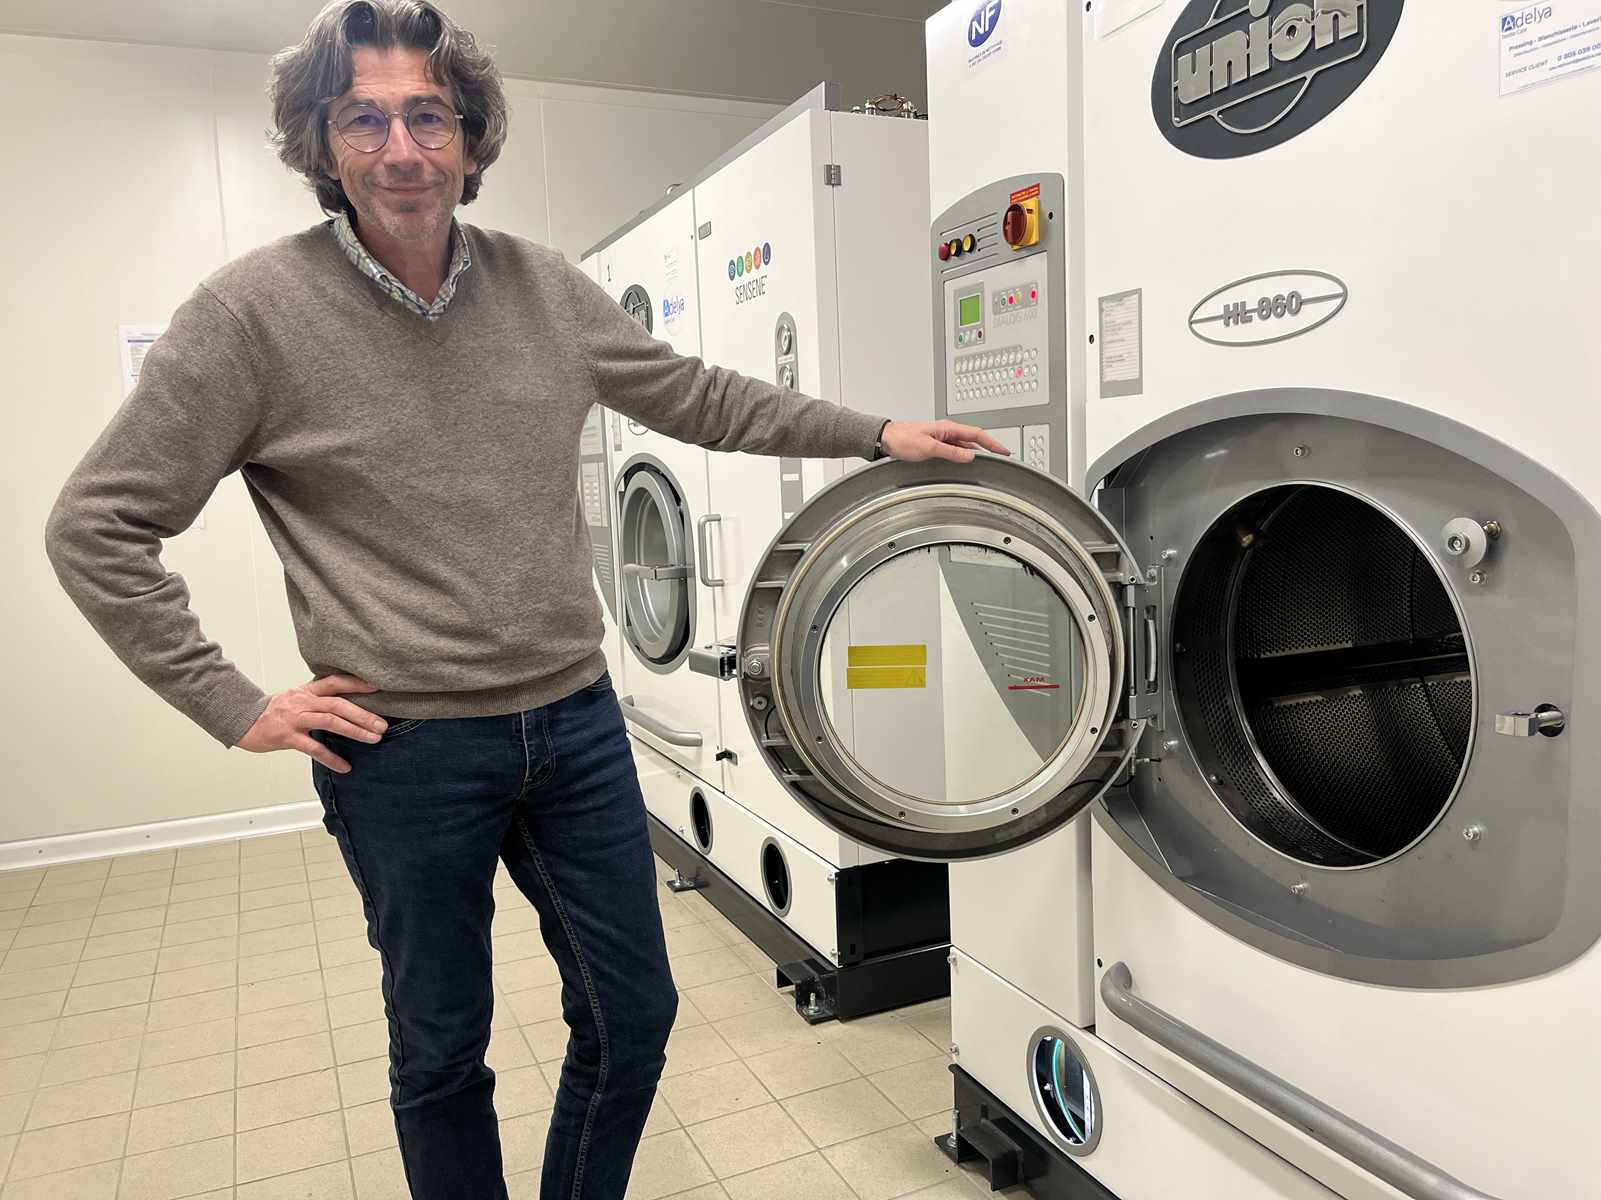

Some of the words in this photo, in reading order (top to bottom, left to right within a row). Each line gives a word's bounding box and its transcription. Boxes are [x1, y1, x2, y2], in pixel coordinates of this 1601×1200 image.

[971, 0, 1000, 40] NF
[1501, 6, 1552, 33] Adelya
[1177, 0, 1359, 105] union
